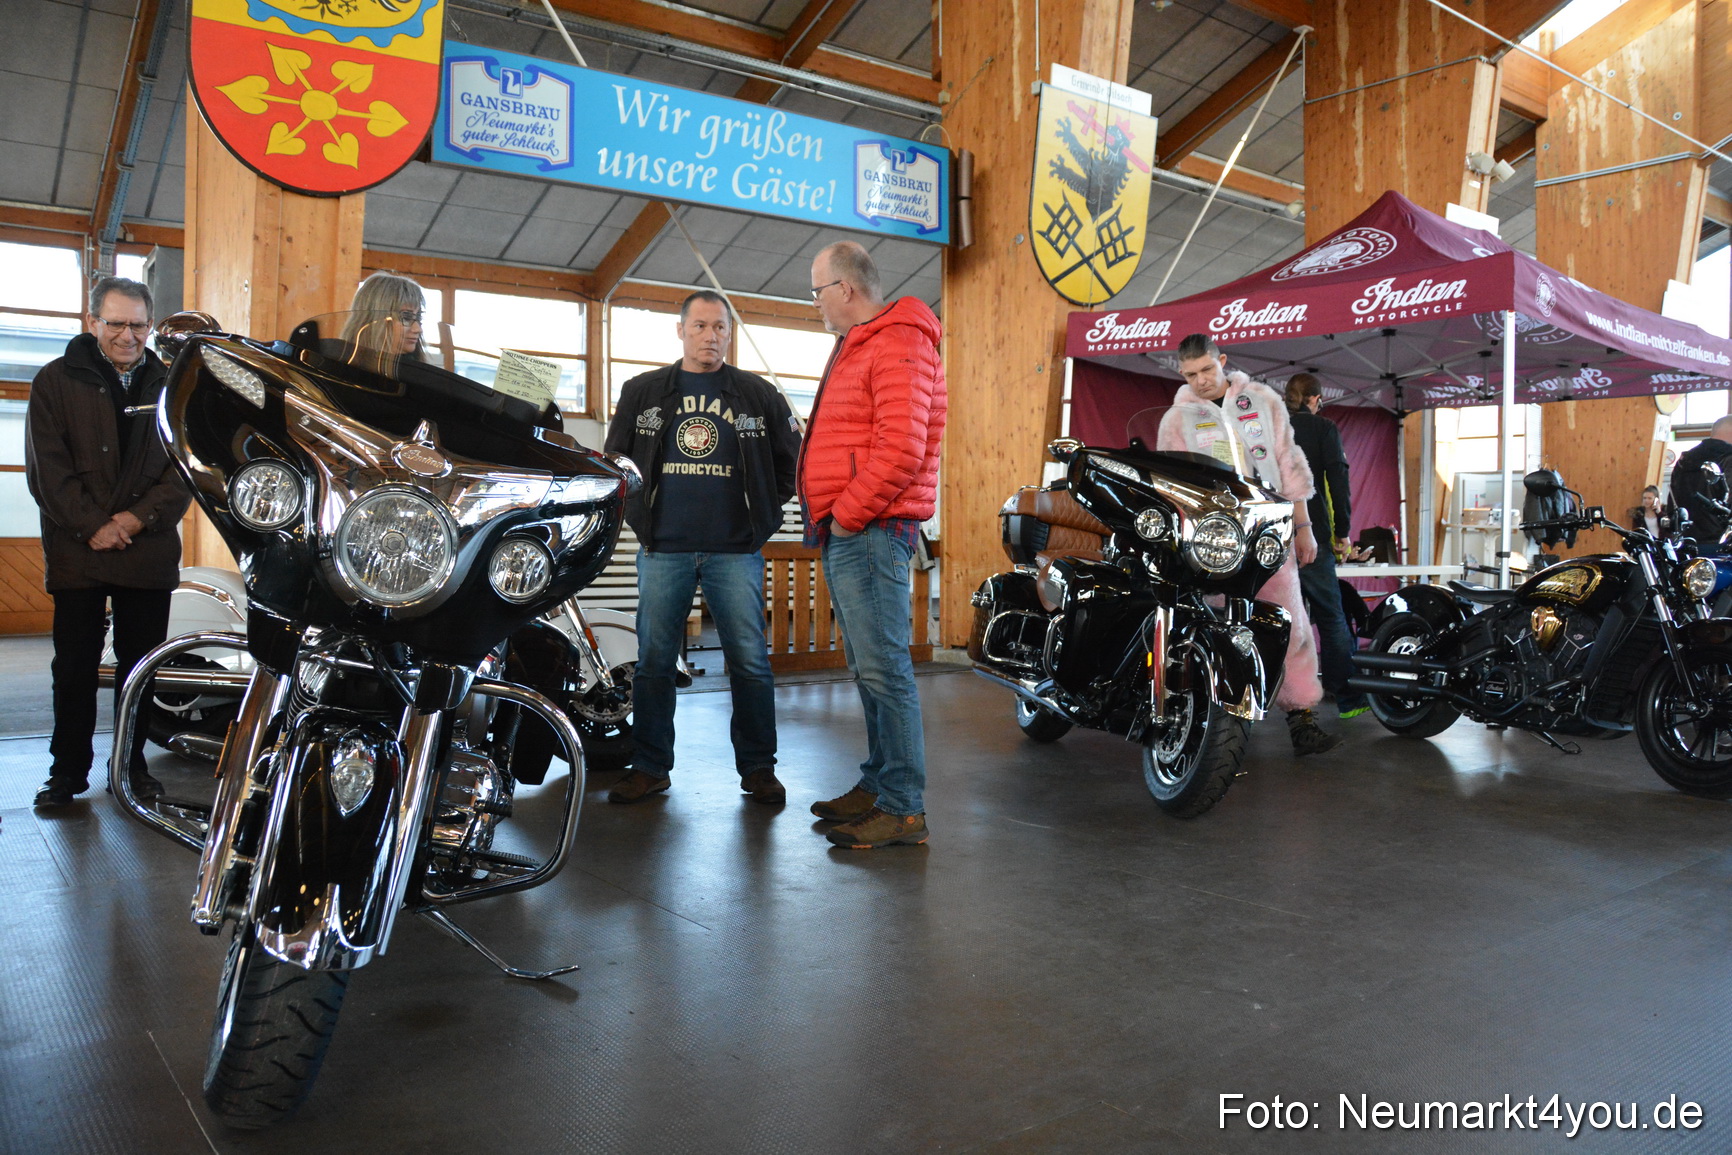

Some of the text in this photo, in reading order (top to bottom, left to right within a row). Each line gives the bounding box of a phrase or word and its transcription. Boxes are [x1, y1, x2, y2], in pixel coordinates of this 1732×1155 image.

[460, 92, 560, 121] GANSBRÄU
[465, 110, 554, 137] Neumarkt's
[612, 84, 823, 162] Wir grüßen
[460, 129, 559, 156] guter Schluck
[597, 147, 836, 214] unsere Gäste!
[863, 169, 932, 193] GANSBRÄU
[867, 184, 928, 207] Neumarkt's
[864, 199, 931, 222] guter Schluck
[1351, 277, 1467, 315] Indian
[1208, 298, 1308, 332] Indian
[1354, 302, 1462, 325] MOTORCYCLE
[1085, 313, 1171, 342] Indian
[1211, 325, 1303, 341] MOTORCYCLE
[1585, 311, 1731, 366] www.indian-mittelfranken.de
[1088, 340, 1167, 351] MOTORCYCLE
[662, 462, 732, 478] MOTORCYCLE
